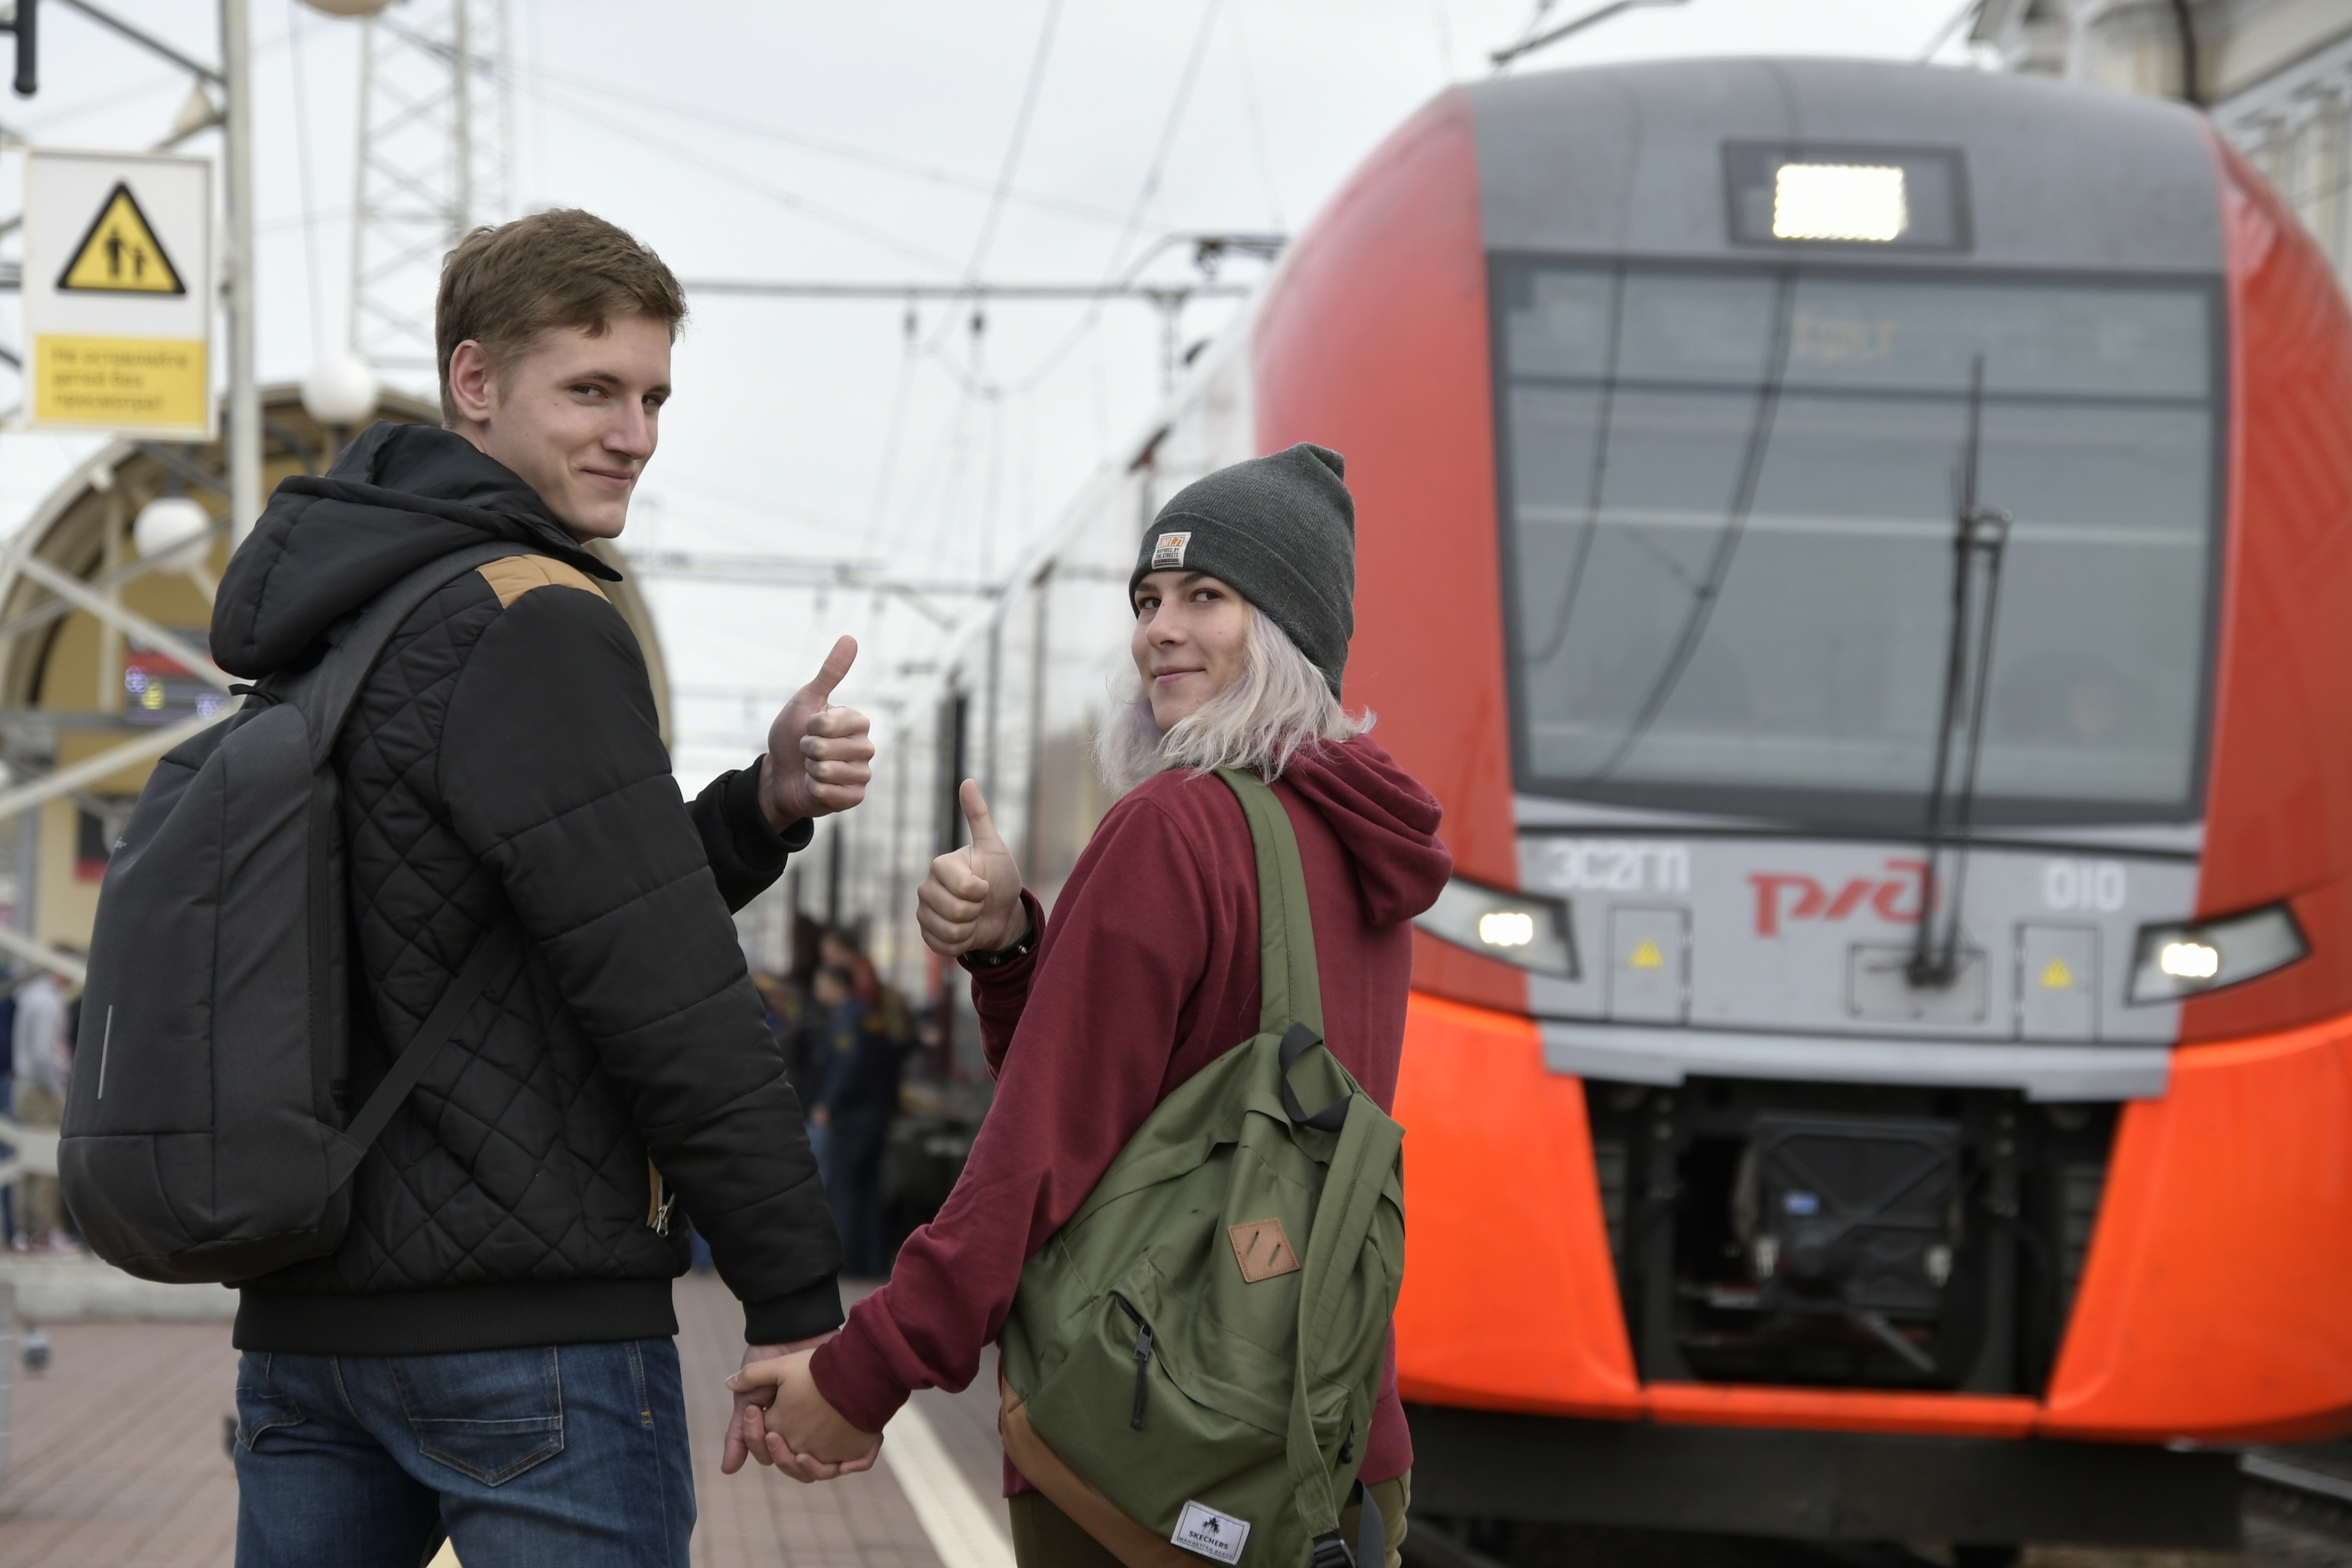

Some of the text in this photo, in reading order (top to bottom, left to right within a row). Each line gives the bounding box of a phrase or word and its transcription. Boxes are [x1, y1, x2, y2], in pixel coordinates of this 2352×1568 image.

[1179, 1537, 1232, 1559] MANHATTAN BEACH
[1189, 1530, 1229, 1550] SKECHERS
